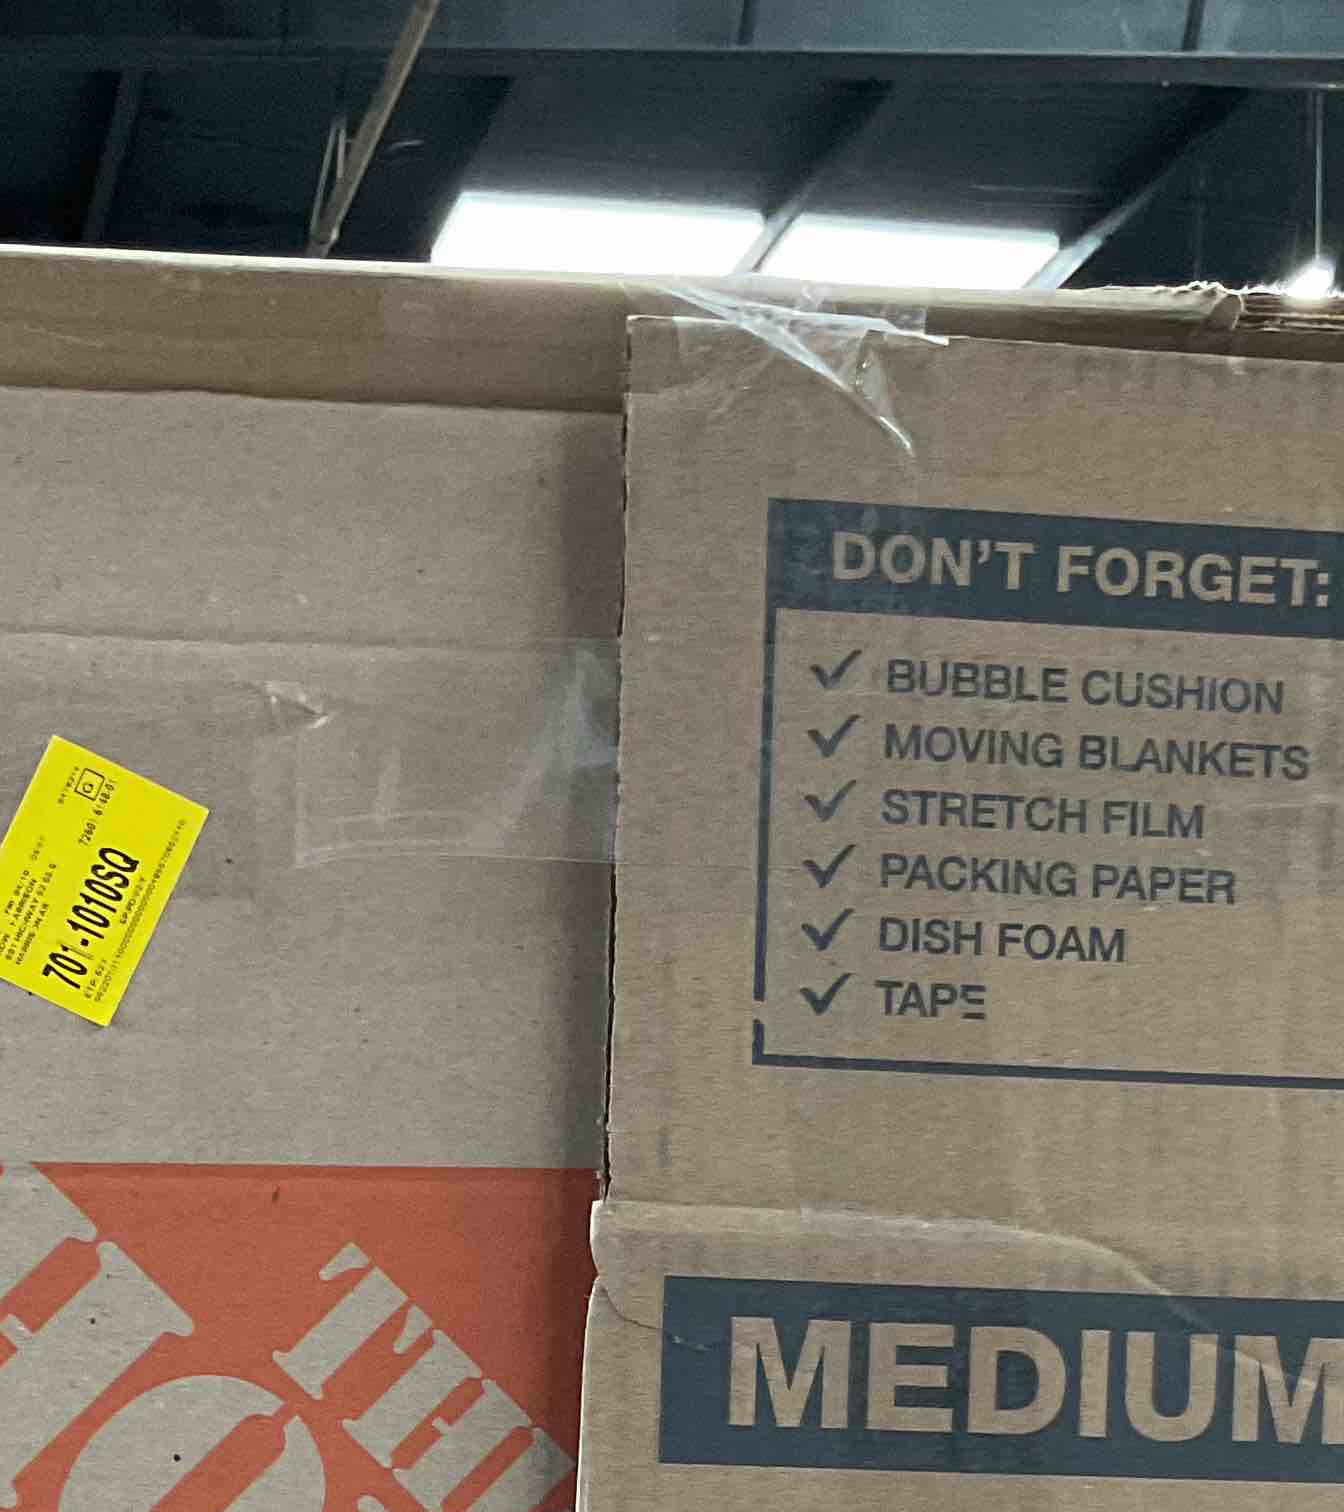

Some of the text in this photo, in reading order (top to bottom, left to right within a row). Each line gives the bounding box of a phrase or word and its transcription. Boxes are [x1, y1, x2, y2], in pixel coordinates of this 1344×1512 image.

[831, 530, 1330, 608] DON'T FORGET:
[886, 657, 1285, 714] BUBBLE CUSHION
[882, 722, 1311, 781] MOVING BLANKETS
[881, 788, 1205, 840] STRETCH FILM
[879, 852, 1237, 905] PACKING PAPER
[878, 915, 1127, 963] DISH FOAM
[874, 979, 987, 1021] TAPE
